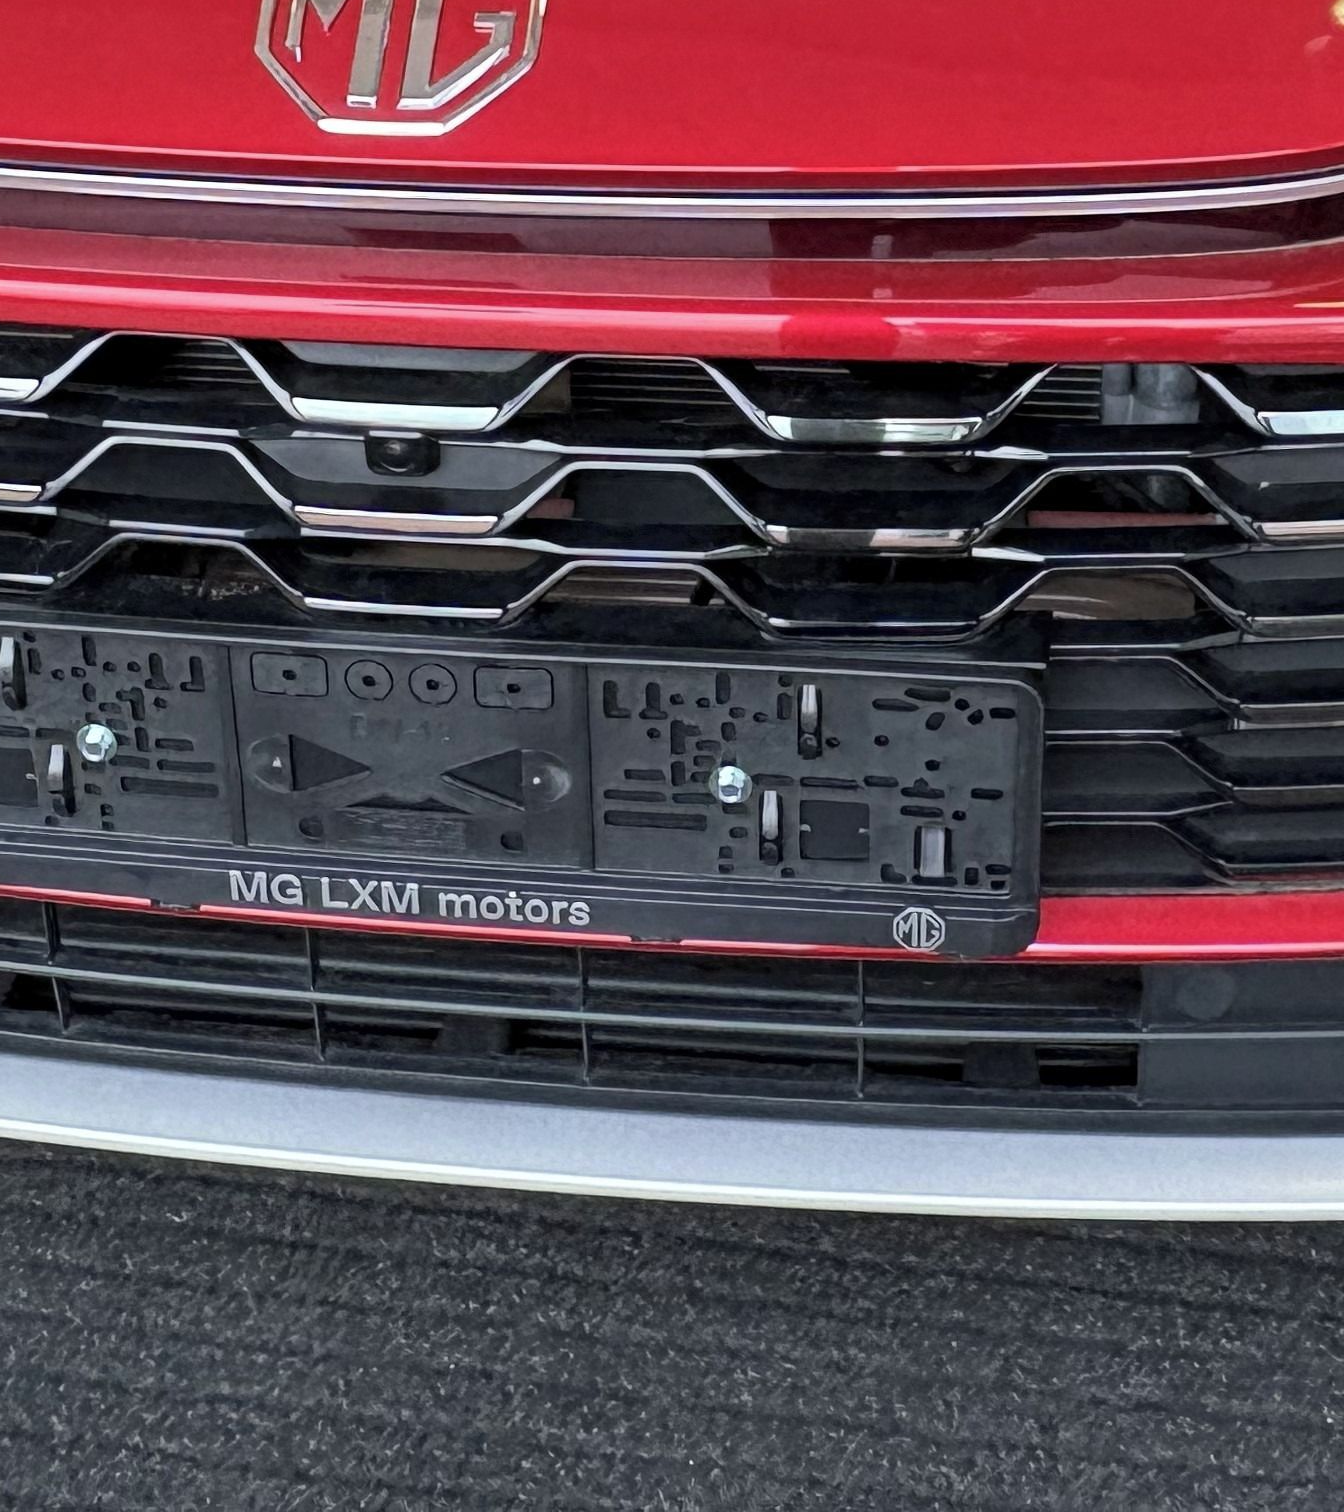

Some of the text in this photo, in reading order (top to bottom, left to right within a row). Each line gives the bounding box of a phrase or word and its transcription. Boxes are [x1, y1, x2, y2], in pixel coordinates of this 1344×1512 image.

[228, 869, 591, 926] MG LXM motors
[898, 911, 941, 948] MG
